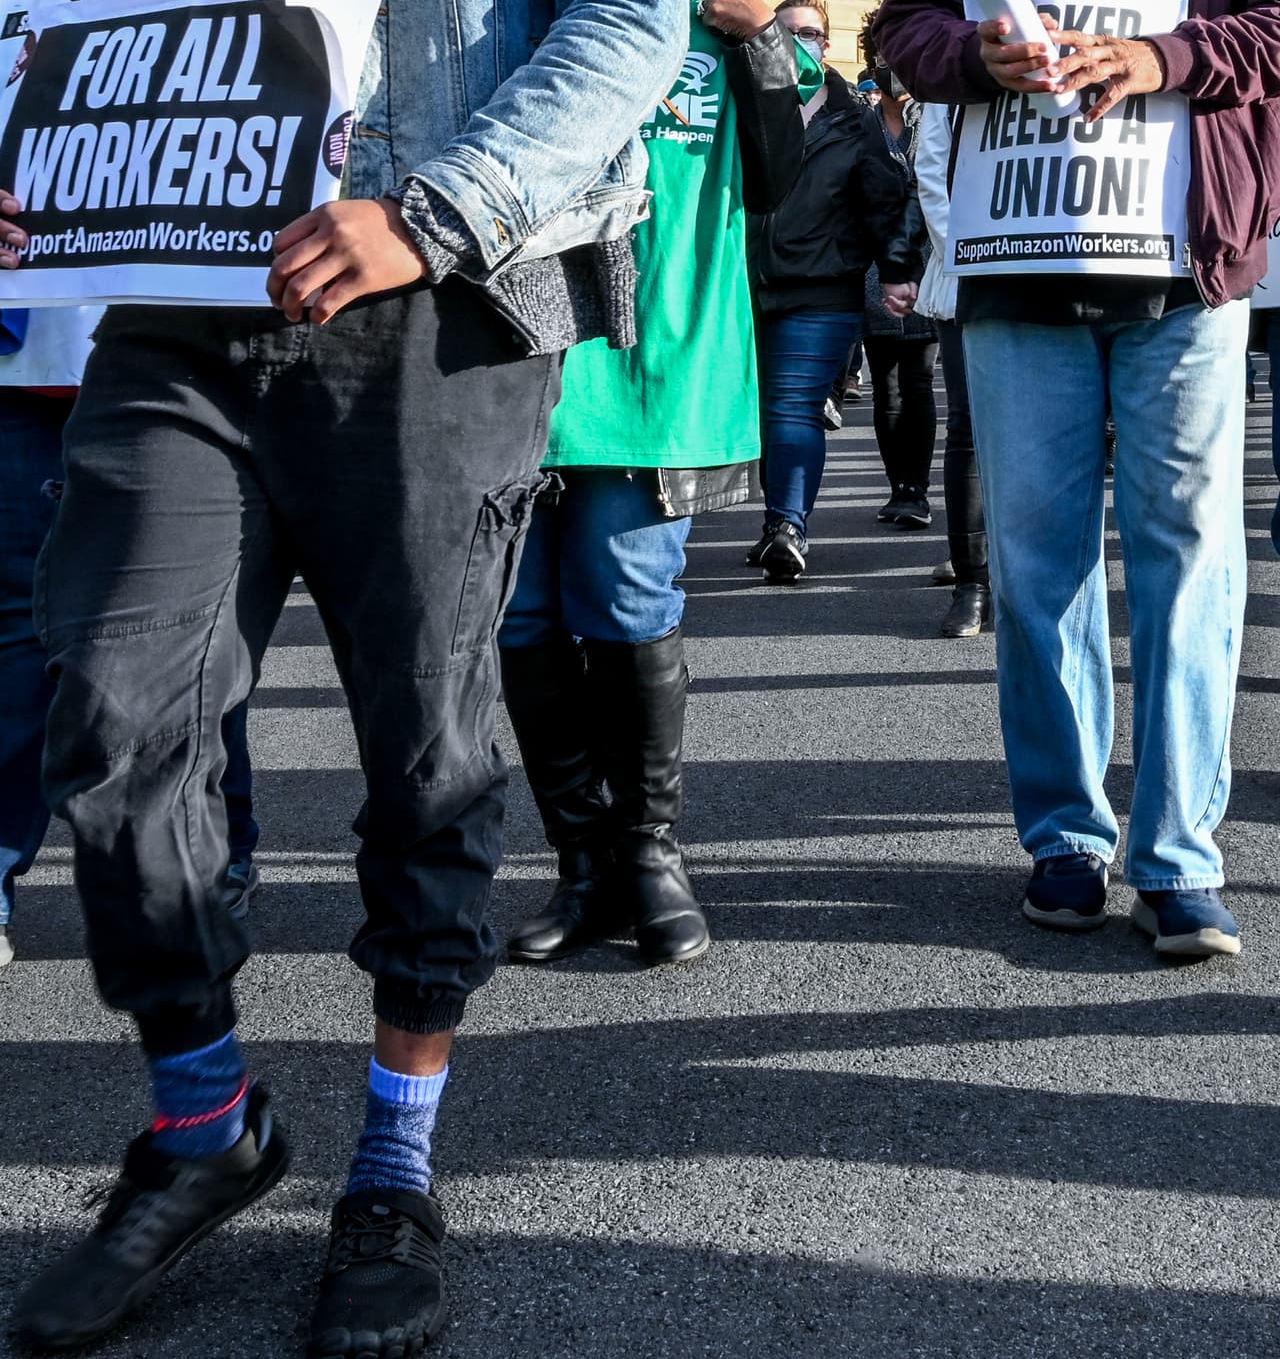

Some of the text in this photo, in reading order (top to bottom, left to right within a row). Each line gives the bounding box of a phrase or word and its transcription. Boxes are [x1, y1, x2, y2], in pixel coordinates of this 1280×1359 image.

[58, 23, 170, 111] FOR
[157, 14, 263, 103] ALL
[329, 133, 344, 166] NOW!
[656, 126, 714, 144] Happen
[17, 115, 302, 212] WORKERS!
[989, 154, 1149, 219] UNION!
[957, 233, 1170, 263] SupportAmazonWorkers.org
